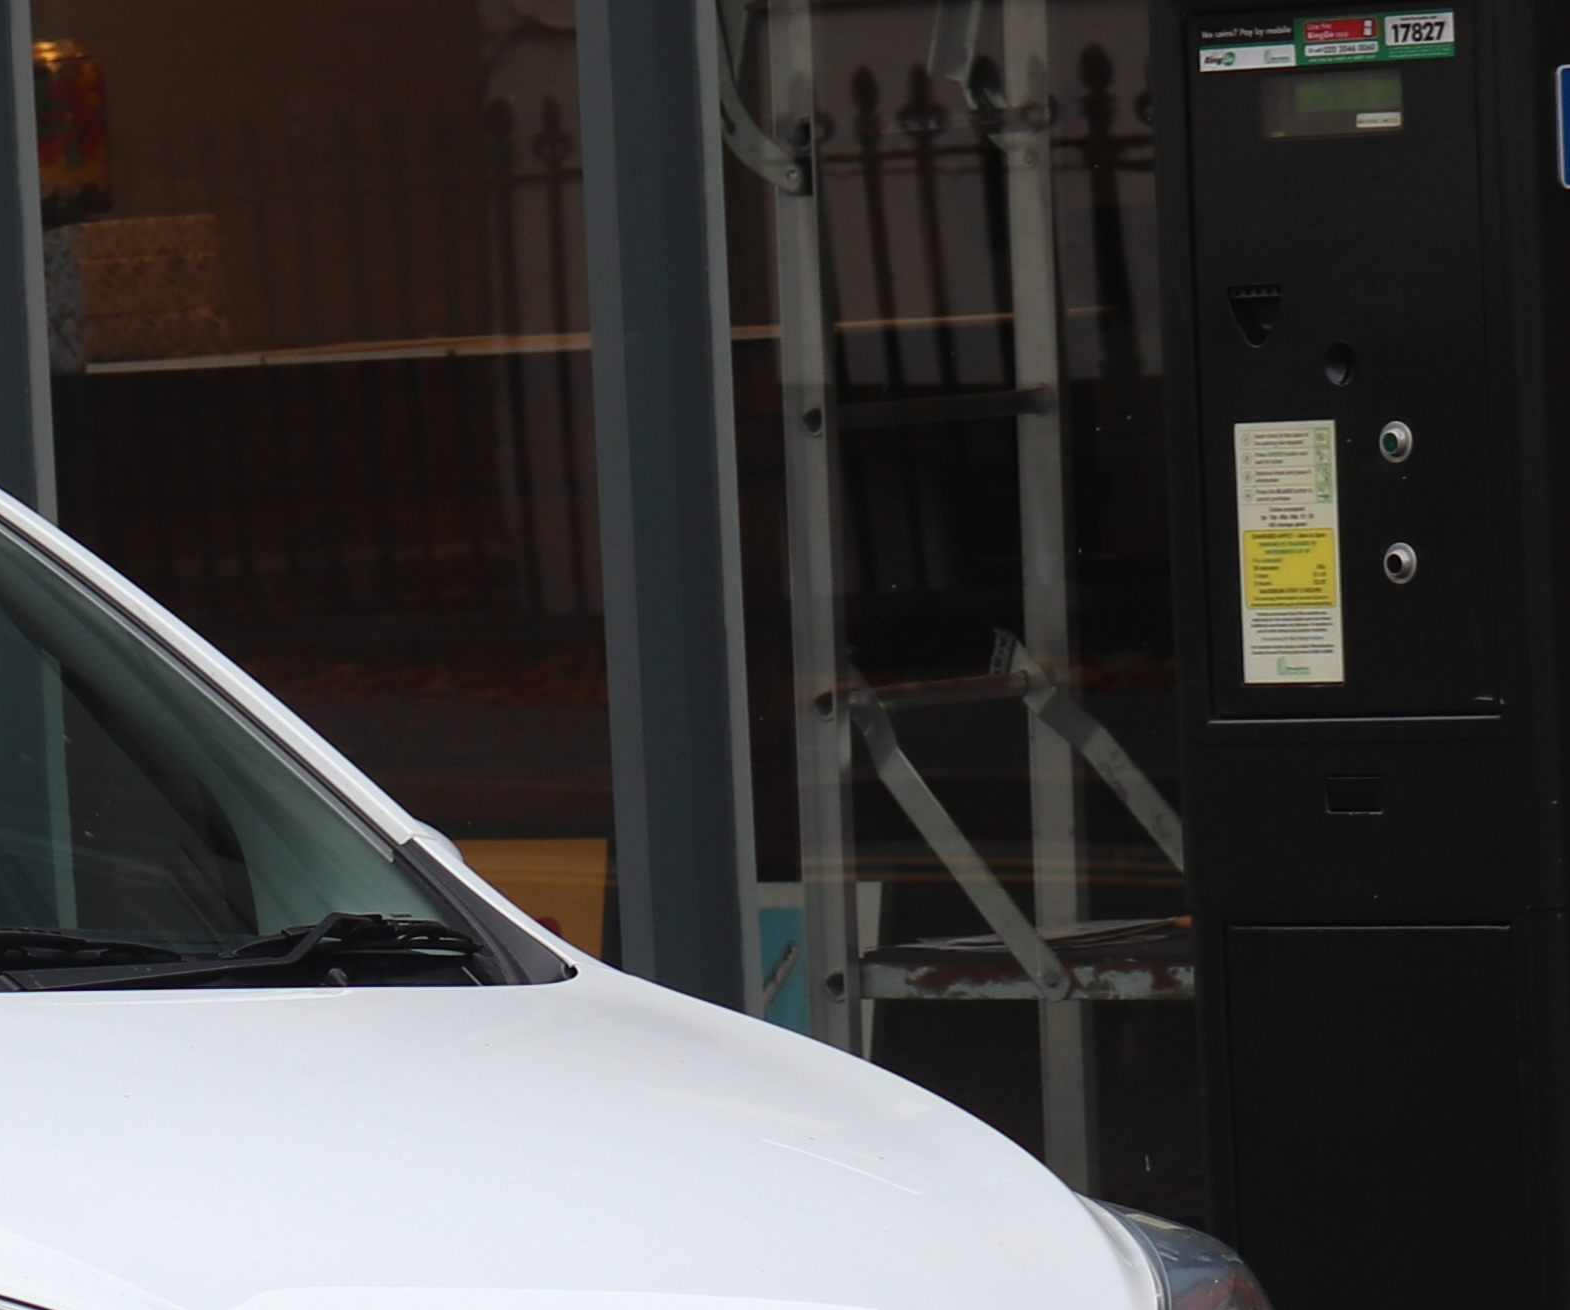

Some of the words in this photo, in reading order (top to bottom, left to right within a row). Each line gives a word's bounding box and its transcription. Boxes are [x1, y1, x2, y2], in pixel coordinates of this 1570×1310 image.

[1239, 28, 1253, 38] Pay
[1265, 26, 1291, 34] mobile
[1391, 21, 1445, 43] 17827
